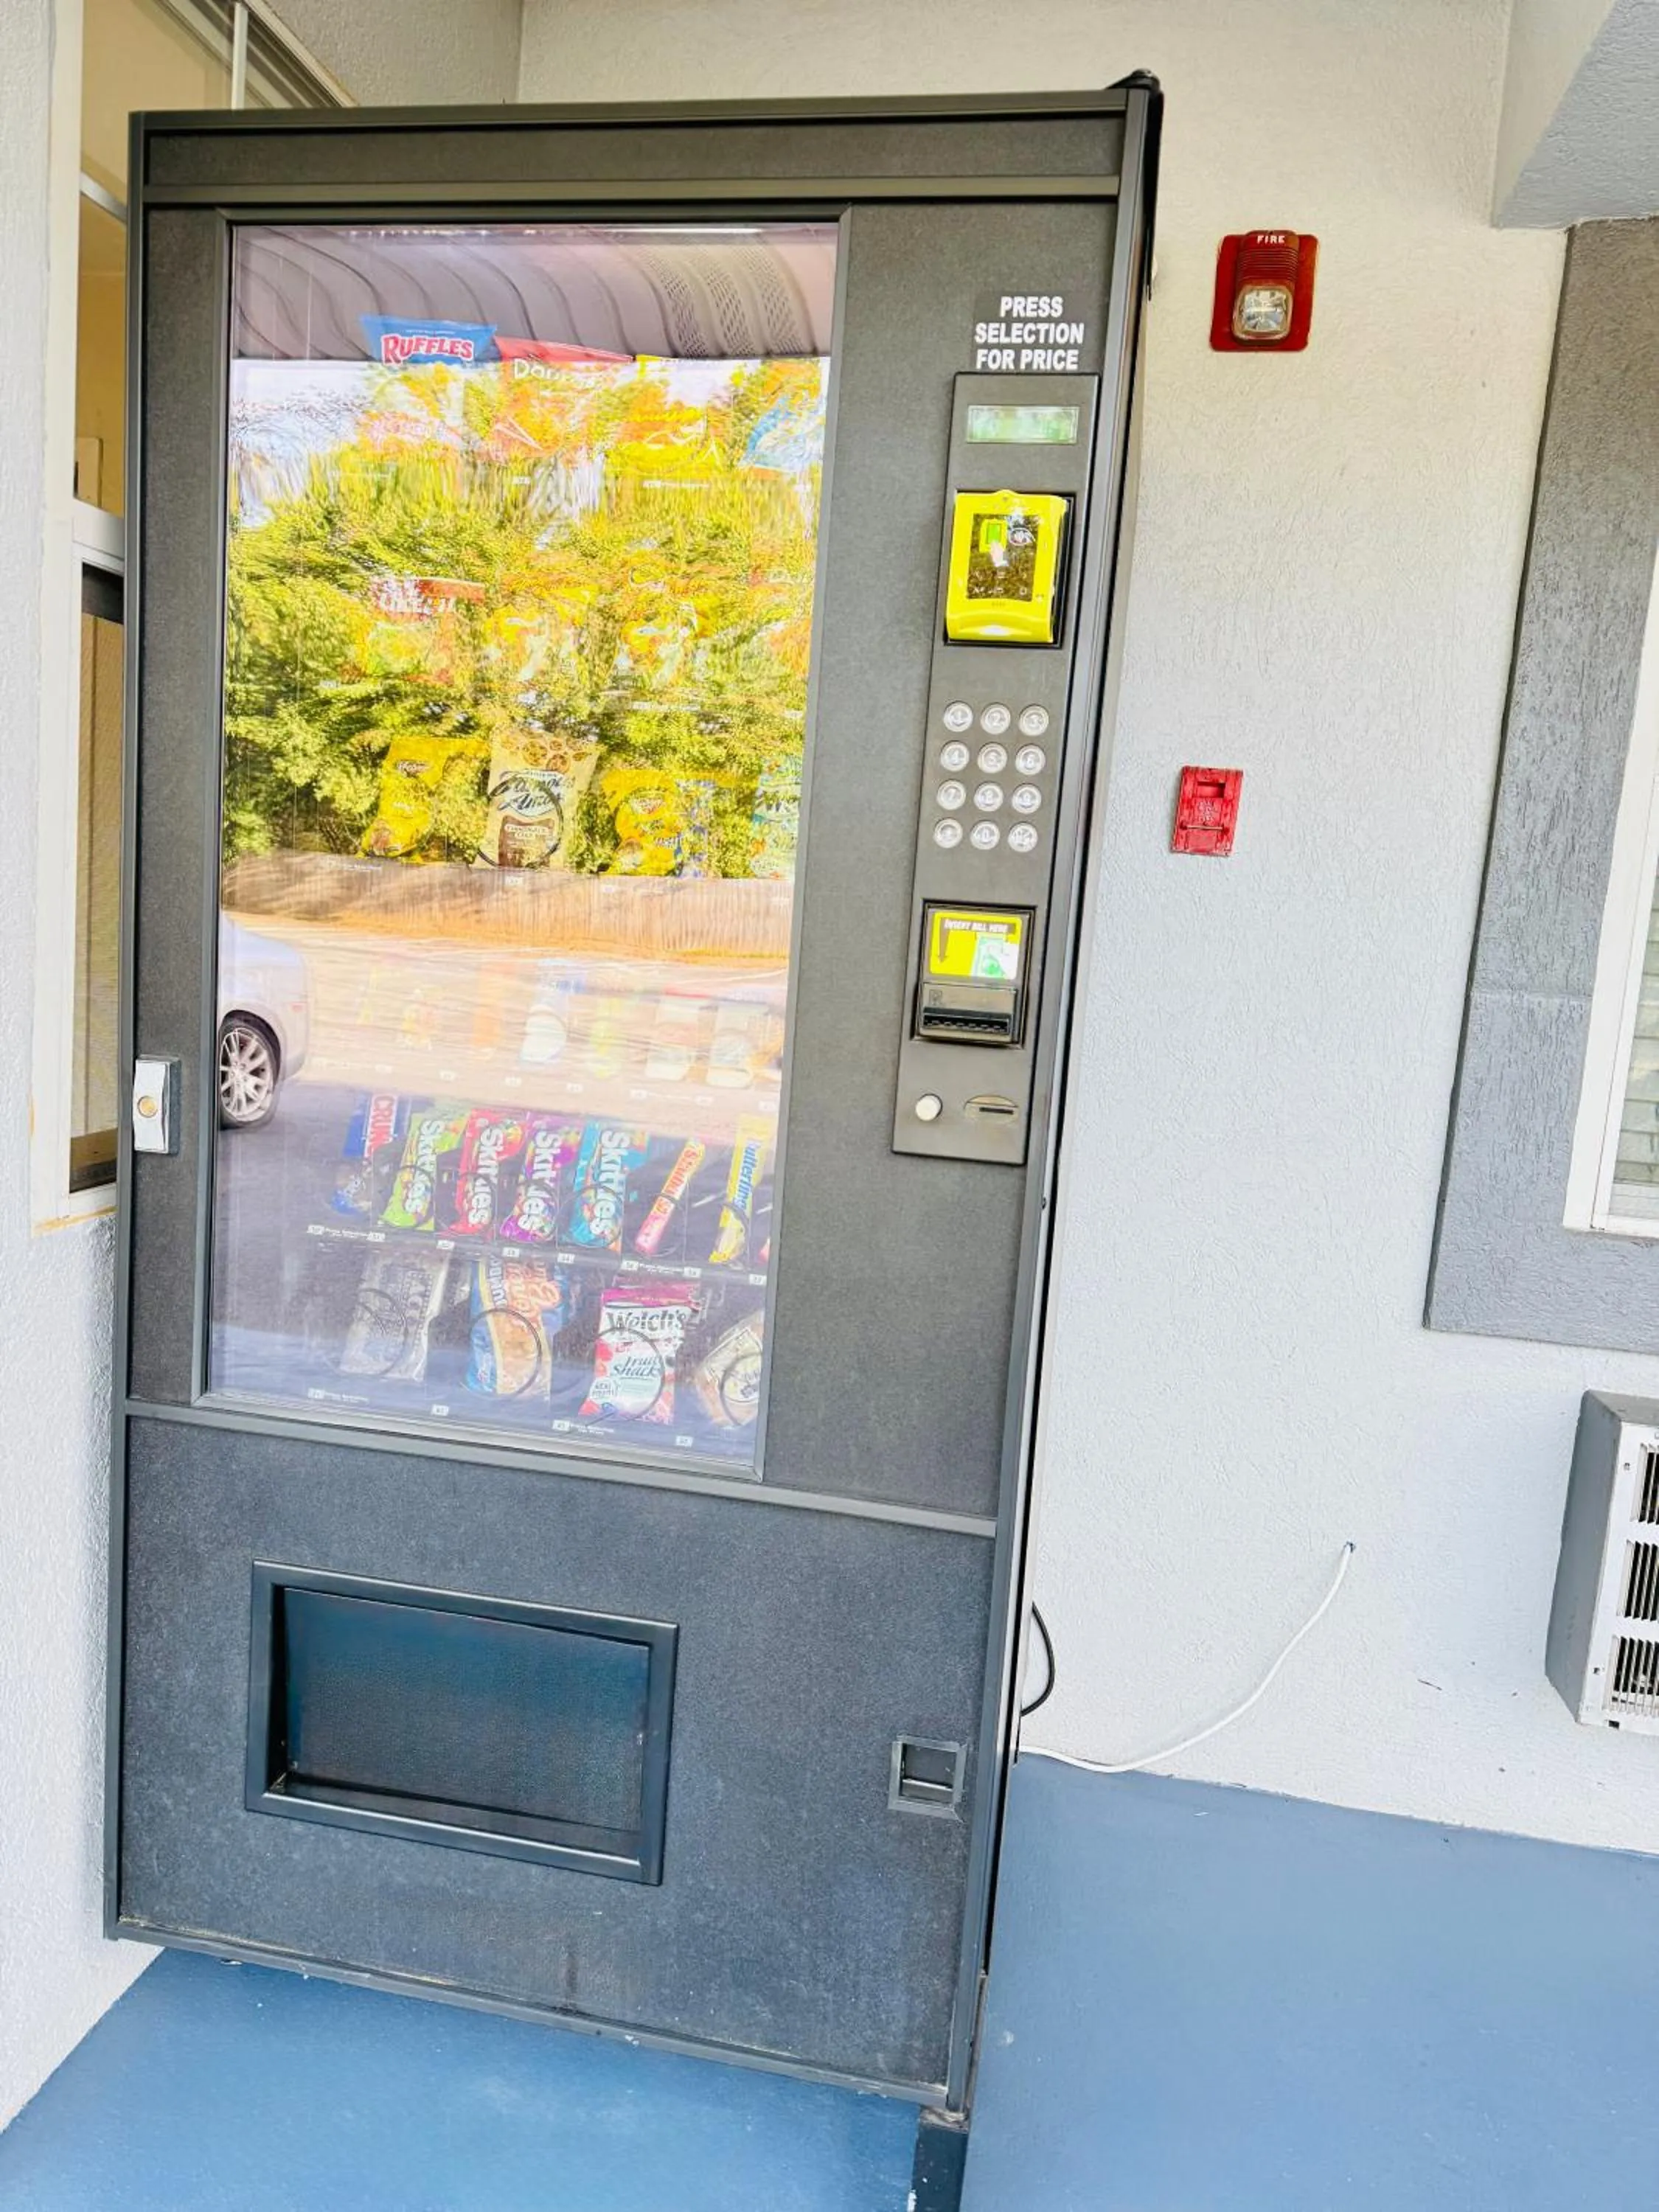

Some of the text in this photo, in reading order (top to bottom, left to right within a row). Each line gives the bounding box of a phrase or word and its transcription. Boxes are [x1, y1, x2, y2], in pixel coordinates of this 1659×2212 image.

[1256, 235, 1285, 243] FIRE
[1000, 296, 1063, 318] PRESS
[975, 322, 1085, 344] SELECTION
[381, 334, 474, 365] RUFFLES
[975, 349, 1079, 370] FOR PRICE
[608, 1310, 686, 1332] Welch's
